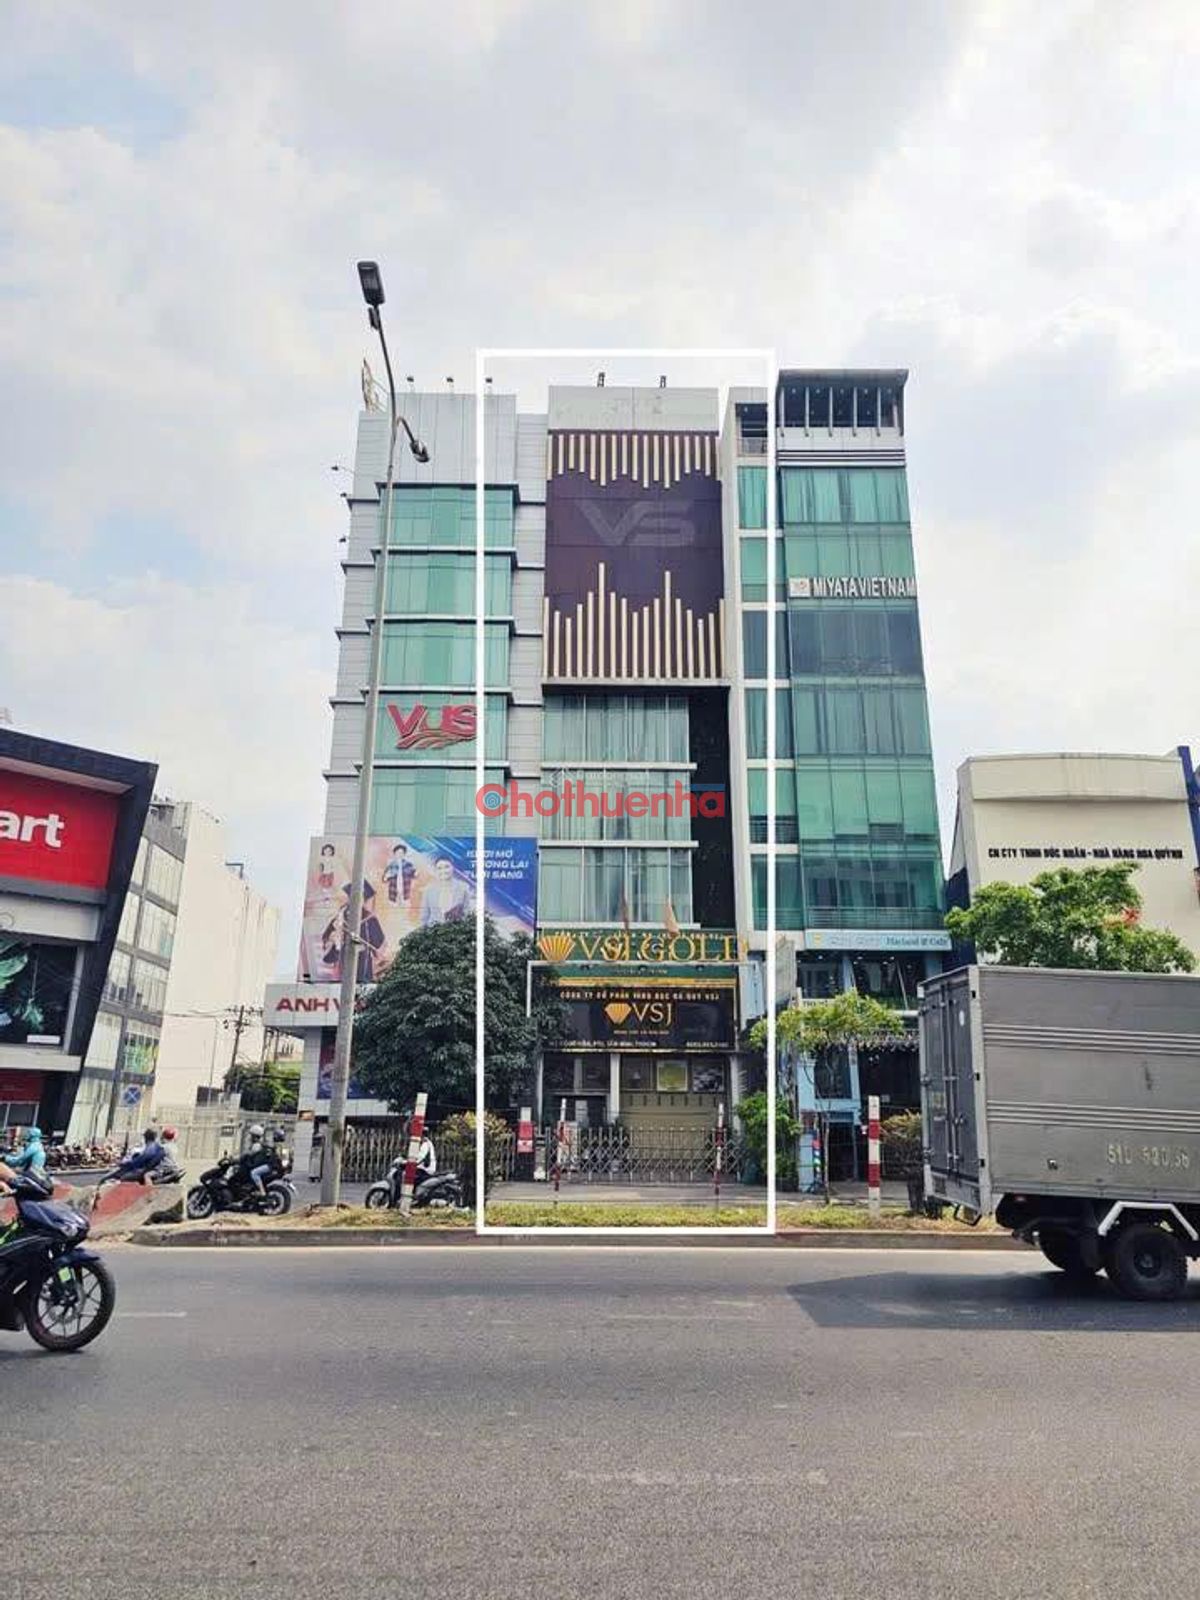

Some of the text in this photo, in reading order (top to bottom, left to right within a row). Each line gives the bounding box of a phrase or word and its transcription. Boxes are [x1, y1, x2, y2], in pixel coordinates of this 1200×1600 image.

[387, 704, 477, 737] VUS
[988, 848, 1000, 858] CN
[1001, 848, 1017, 858] CTY
[510, 860, 529, 869] LAI
[276, 998, 330, 1012] ANH
[632, 1002, 673, 1025] VSJ
